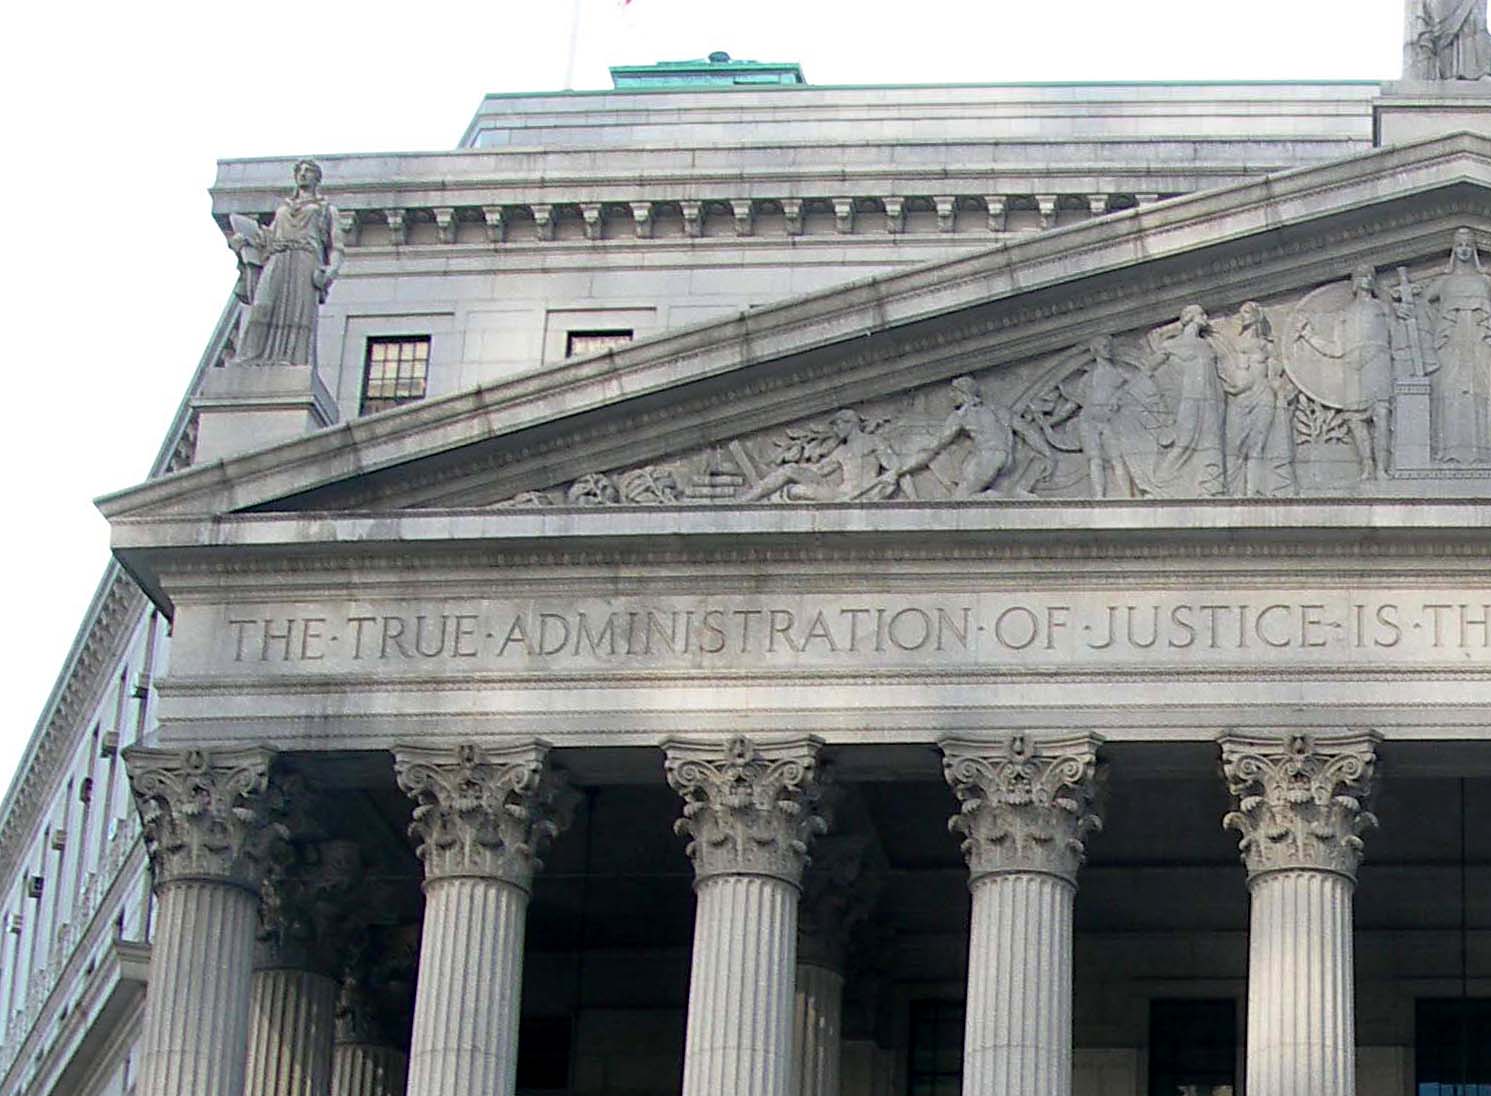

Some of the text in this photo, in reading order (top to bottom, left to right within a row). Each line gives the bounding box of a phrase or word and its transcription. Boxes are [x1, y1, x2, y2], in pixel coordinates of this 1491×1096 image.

[229, 616, 327, 662] THE
[347, 613, 479, 660] TRUE
[496, 606, 971, 657] ADMINISTRATION
[994, 605, 1071, 651] OF
[1086, 604, 1327, 650] JUSTICE
[1353, 603, 1401, 649] IS
